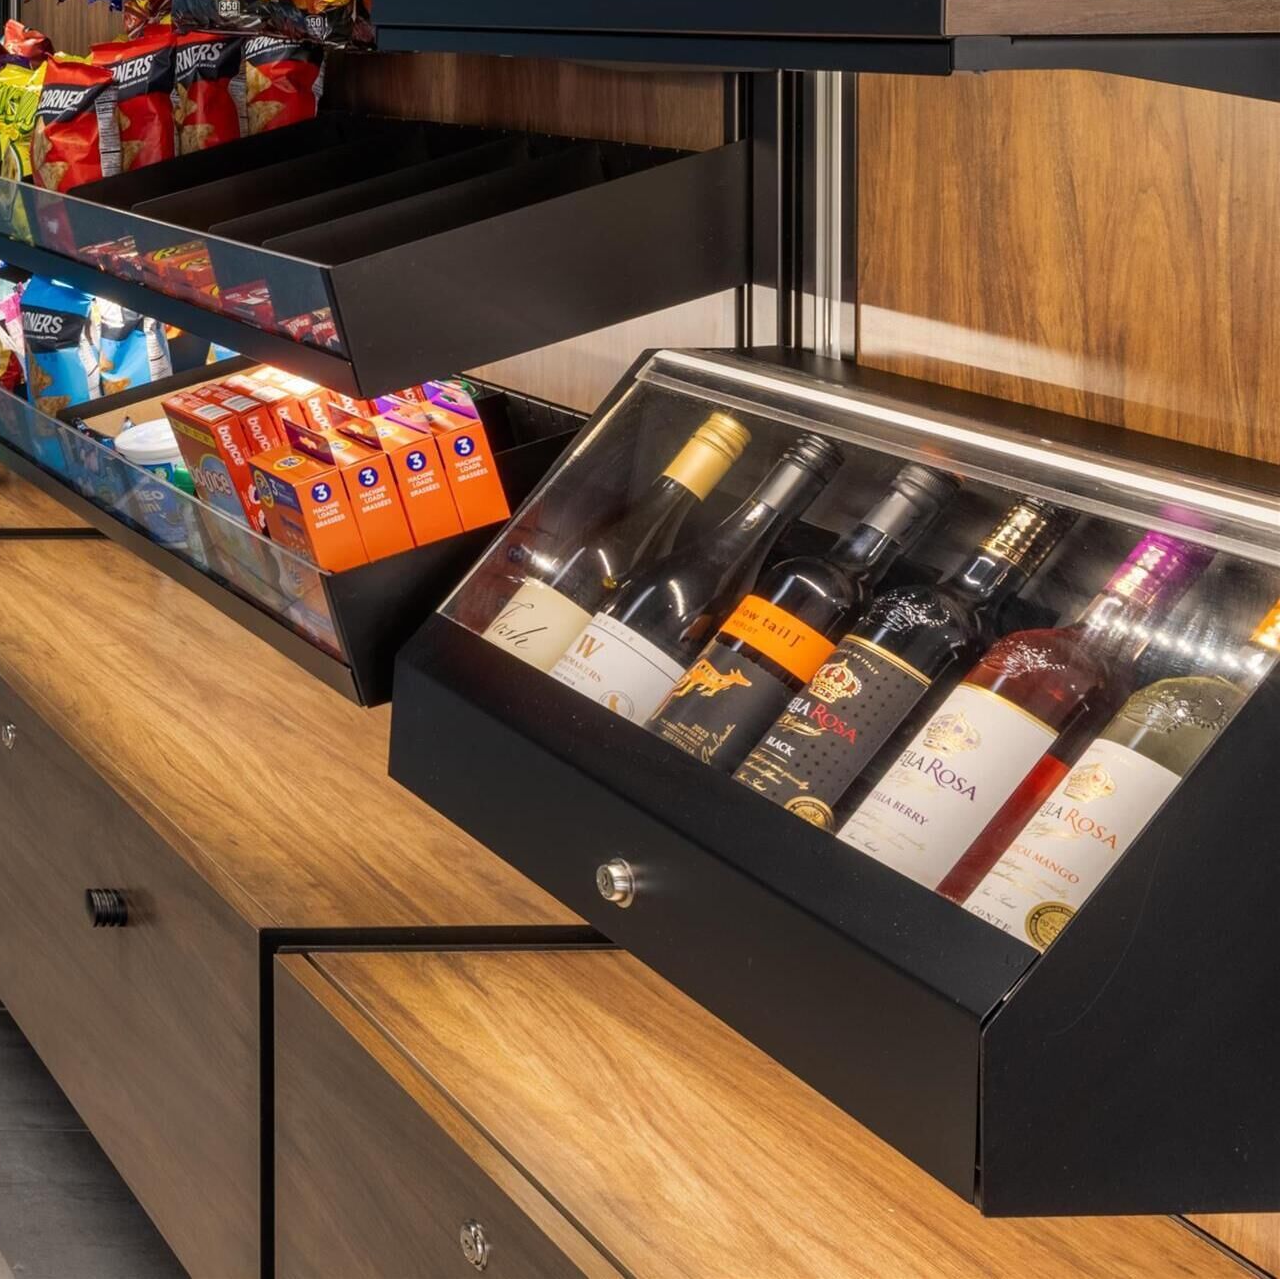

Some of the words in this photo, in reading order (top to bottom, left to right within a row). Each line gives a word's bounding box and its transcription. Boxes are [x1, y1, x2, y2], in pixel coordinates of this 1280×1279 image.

[220, 1, 238, 12] 350
[247, 416, 272, 451] bounc
[217, 425, 245, 465] bounce
[457, 438, 470, 454] 3
[409, 453, 422, 469] 3
[455, 455, 483, 468] MACHINE
[460, 462, 481, 473] LOADS
[362, 469, 374, 485] 3
[408, 470, 435, 483] MACHINE
[412, 477, 433, 488] LOADS
[315, 485, 327, 500] 3
[360, 485, 386, 499] MACHINE
[364, 493, 384, 504] LOADS
[313, 501, 339, 514] MACHINE
[317, 508, 338, 519] LOADS
[762, 615, 792, 640] tail
[576, 634, 604, 659] W
[810, 703, 858, 745] ROSA
[765, 736, 795, 757] BLACK
[924, 758, 977, 801] ROSA
[892, 800, 928, 827] BERRY
[1064, 807, 1118, 850] ROSA
[1032, 854, 1080, 885] MANGO
